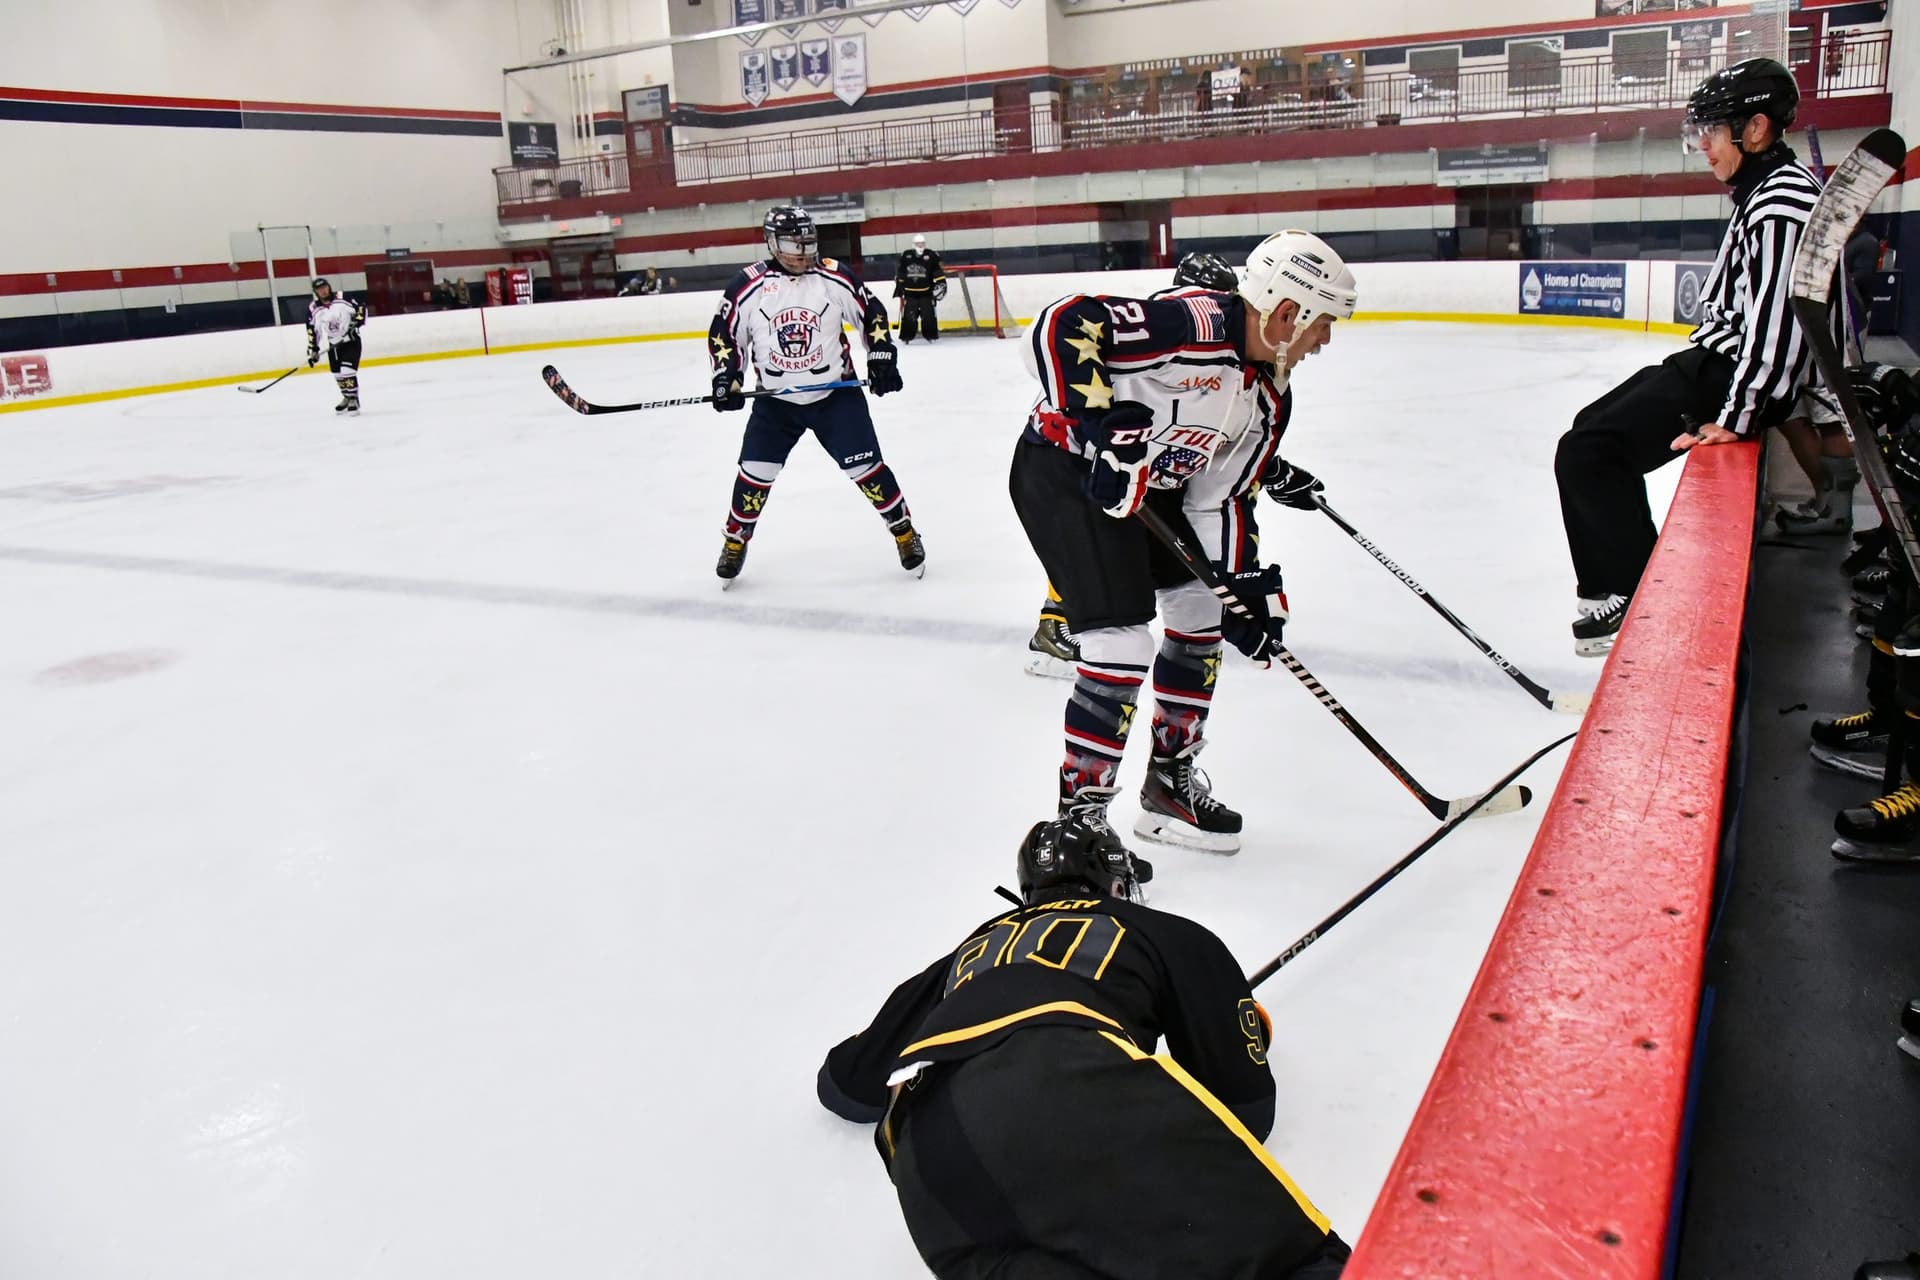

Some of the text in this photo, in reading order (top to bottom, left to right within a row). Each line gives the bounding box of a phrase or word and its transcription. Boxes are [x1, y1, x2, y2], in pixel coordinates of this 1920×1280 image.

[1124, 57, 1181, 73] MINNESOTA
[1241, 47, 1282, 62] HOCKEY
[1744, 93, 1771, 103] CCM
[1280, 269, 1315, 291] BAUER
[1544, 273, 1623, 290] Home of Champions
[770, 308, 820, 328] TULSA
[1103, 301, 1150, 345] 21
[770, 346, 823, 370] WARRIORS
[641, 397, 704, 410] BAUER
[844, 450, 874, 465] CCM
[1353, 531, 1428, 596] SHERWOOD
[1235, 571, 1262, 580] CCM
[1107, 853, 1124, 862] CCM
[1279, 930, 1318, 967] CCM
